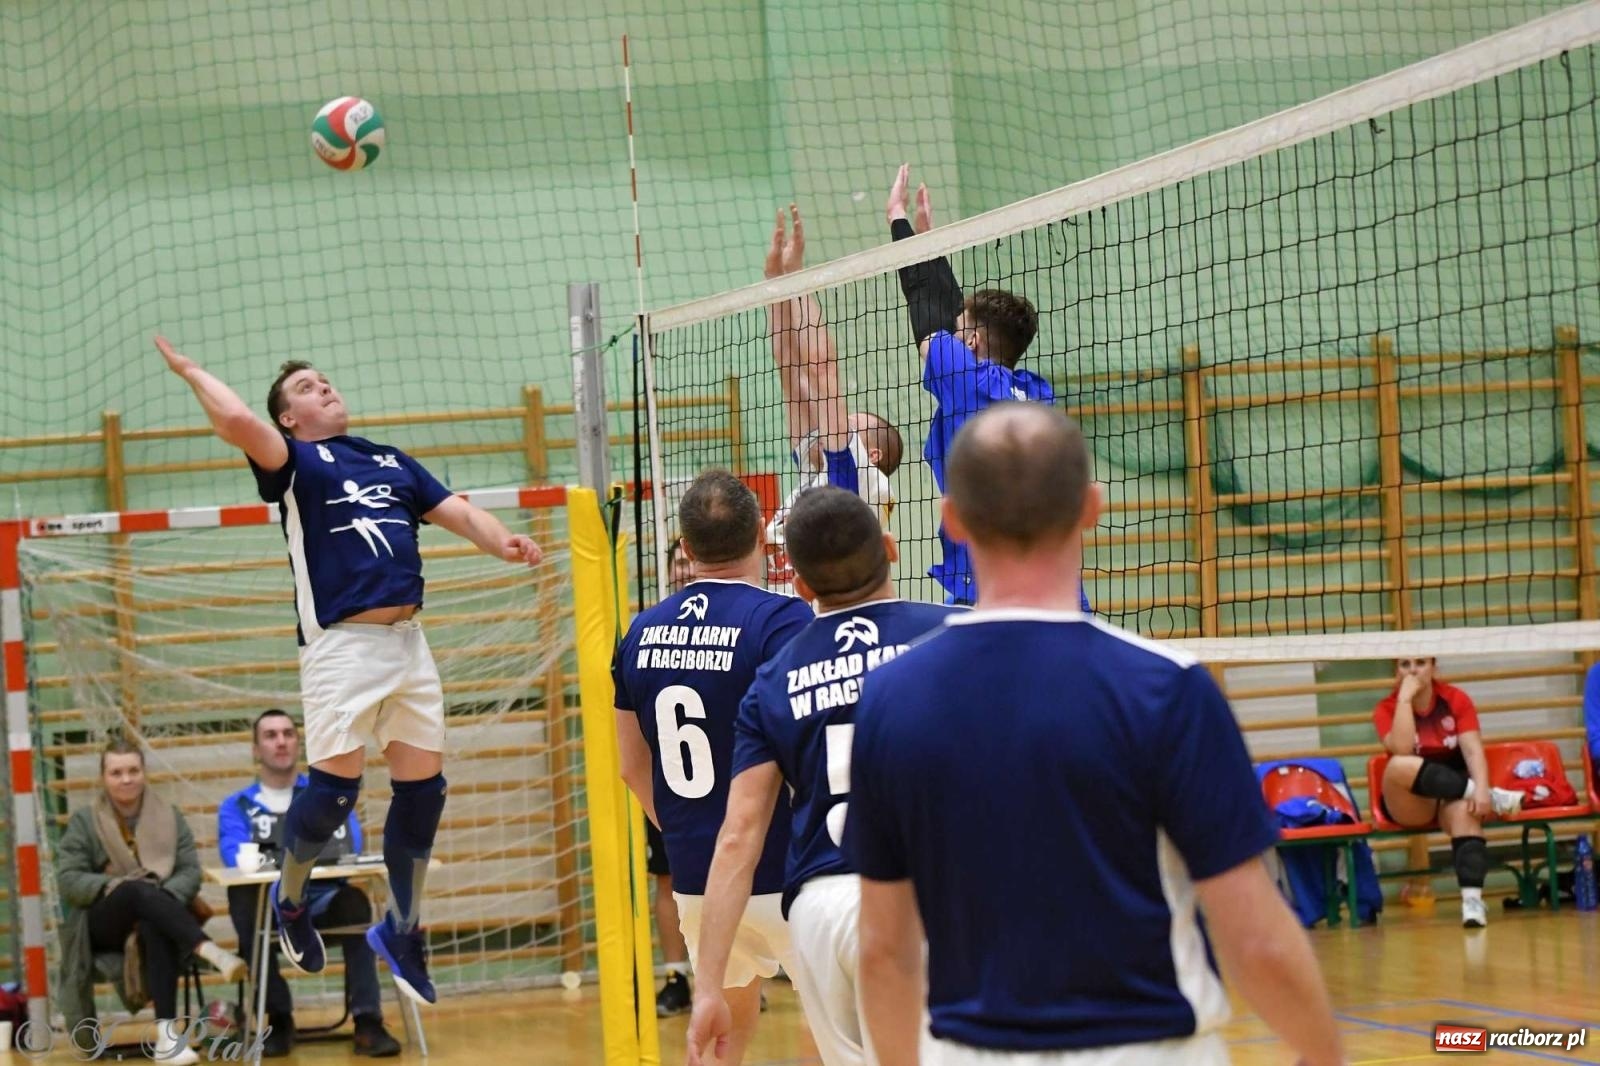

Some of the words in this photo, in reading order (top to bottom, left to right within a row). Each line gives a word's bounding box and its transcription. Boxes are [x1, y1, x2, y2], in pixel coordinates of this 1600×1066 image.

[639, 625, 689, 646] ZAKŁAD
[690, 625, 741, 647] KARNY
[637, 649, 649, 669] W
[651, 649, 734, 672] RACIBORZU
[787, 653, 863, 694] ZAKŁAD
[789, 691, 812, 720] W
[655, 684, 715, 799] 6
[258, 814, 272, 839] 9
